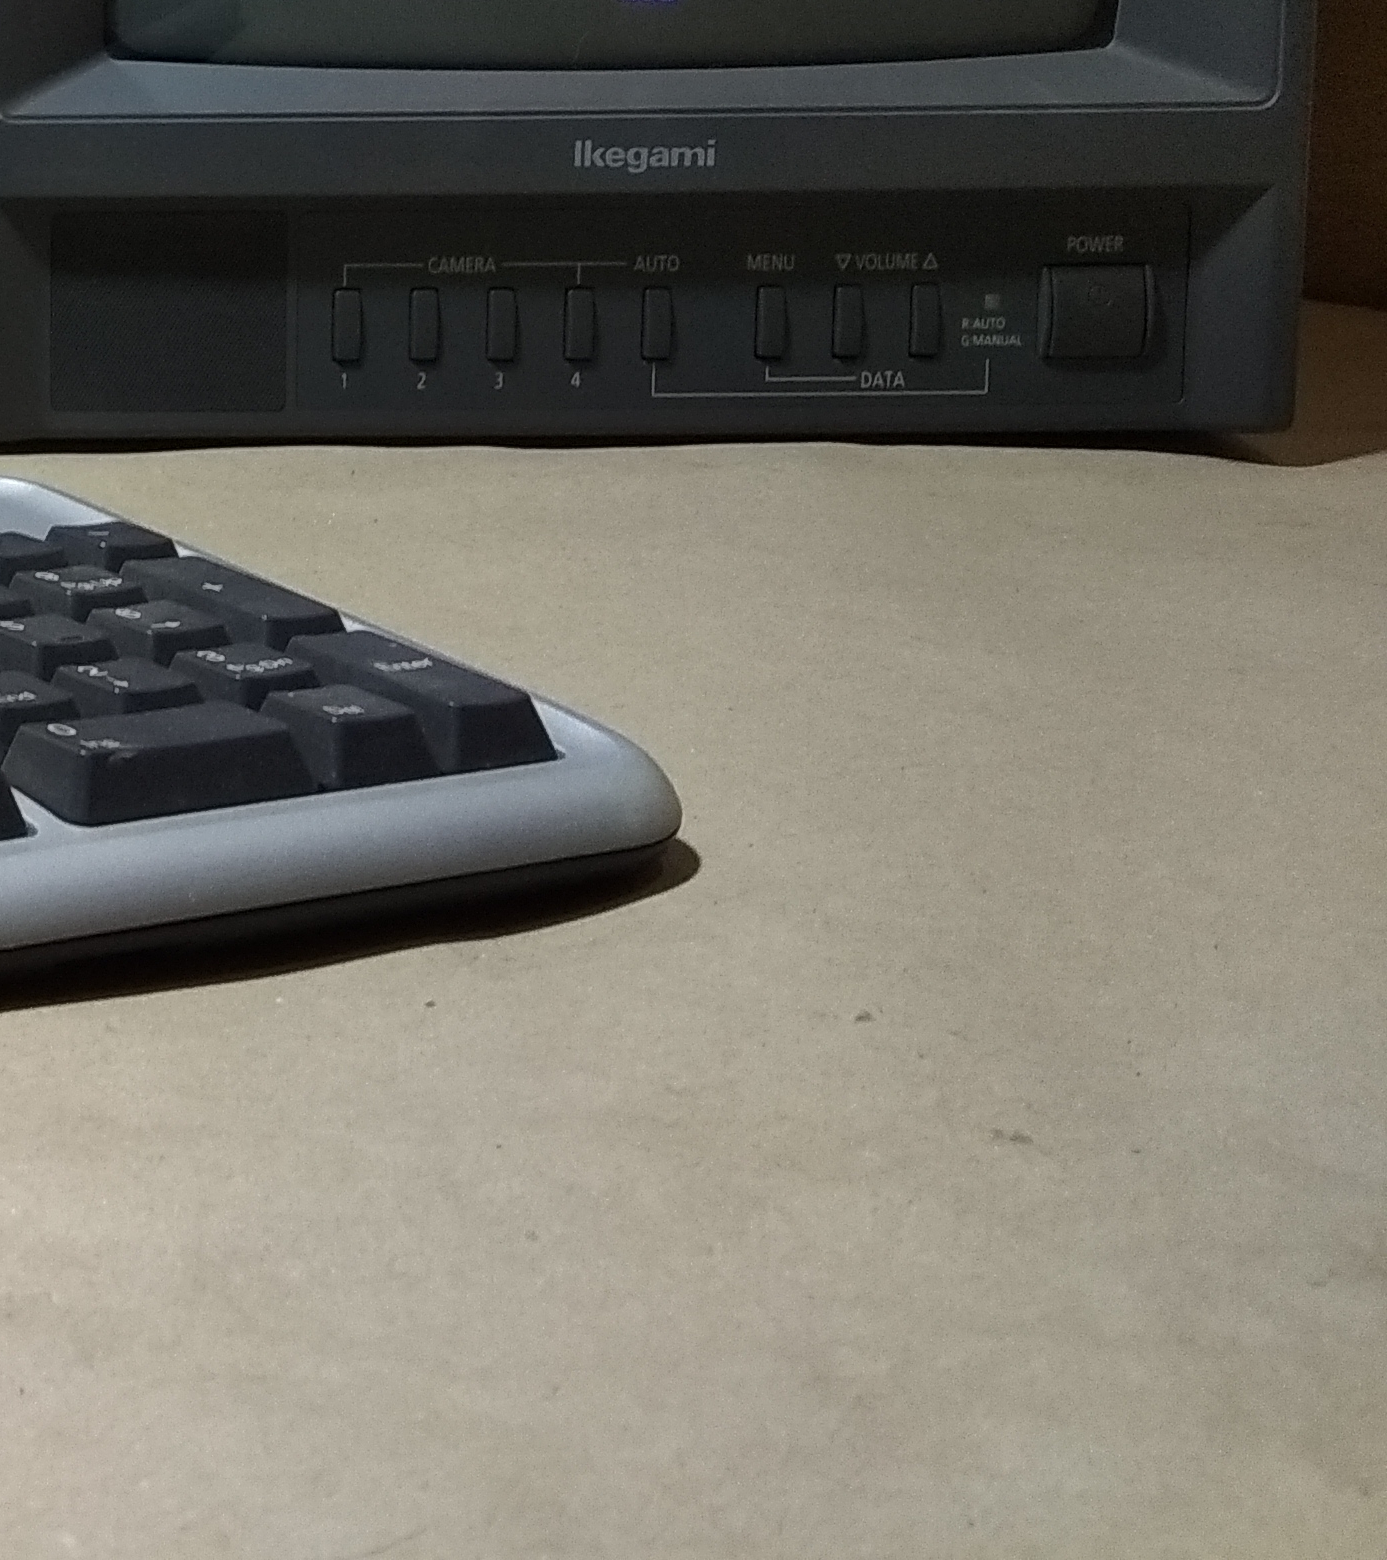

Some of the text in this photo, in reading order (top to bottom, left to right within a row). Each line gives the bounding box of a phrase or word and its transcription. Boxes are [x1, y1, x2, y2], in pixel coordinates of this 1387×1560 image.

[573, 138, 717, 173] Ikegami
[1066, 235, 1125, 254] POWER
[428, 256, 497, 276] CAMERA
[633, 254, 681, 274] AUTO
[747, 254, 795, 273] MENU
[854, 252, 920, 272] VOLUME
[339, 372, 348, 391] 1
[416, 372, 427, 391] 2
[493, 372, 505, 390] 3
[570, 371, 583, 389] 4
[860, 369, 906, 389] DATA
